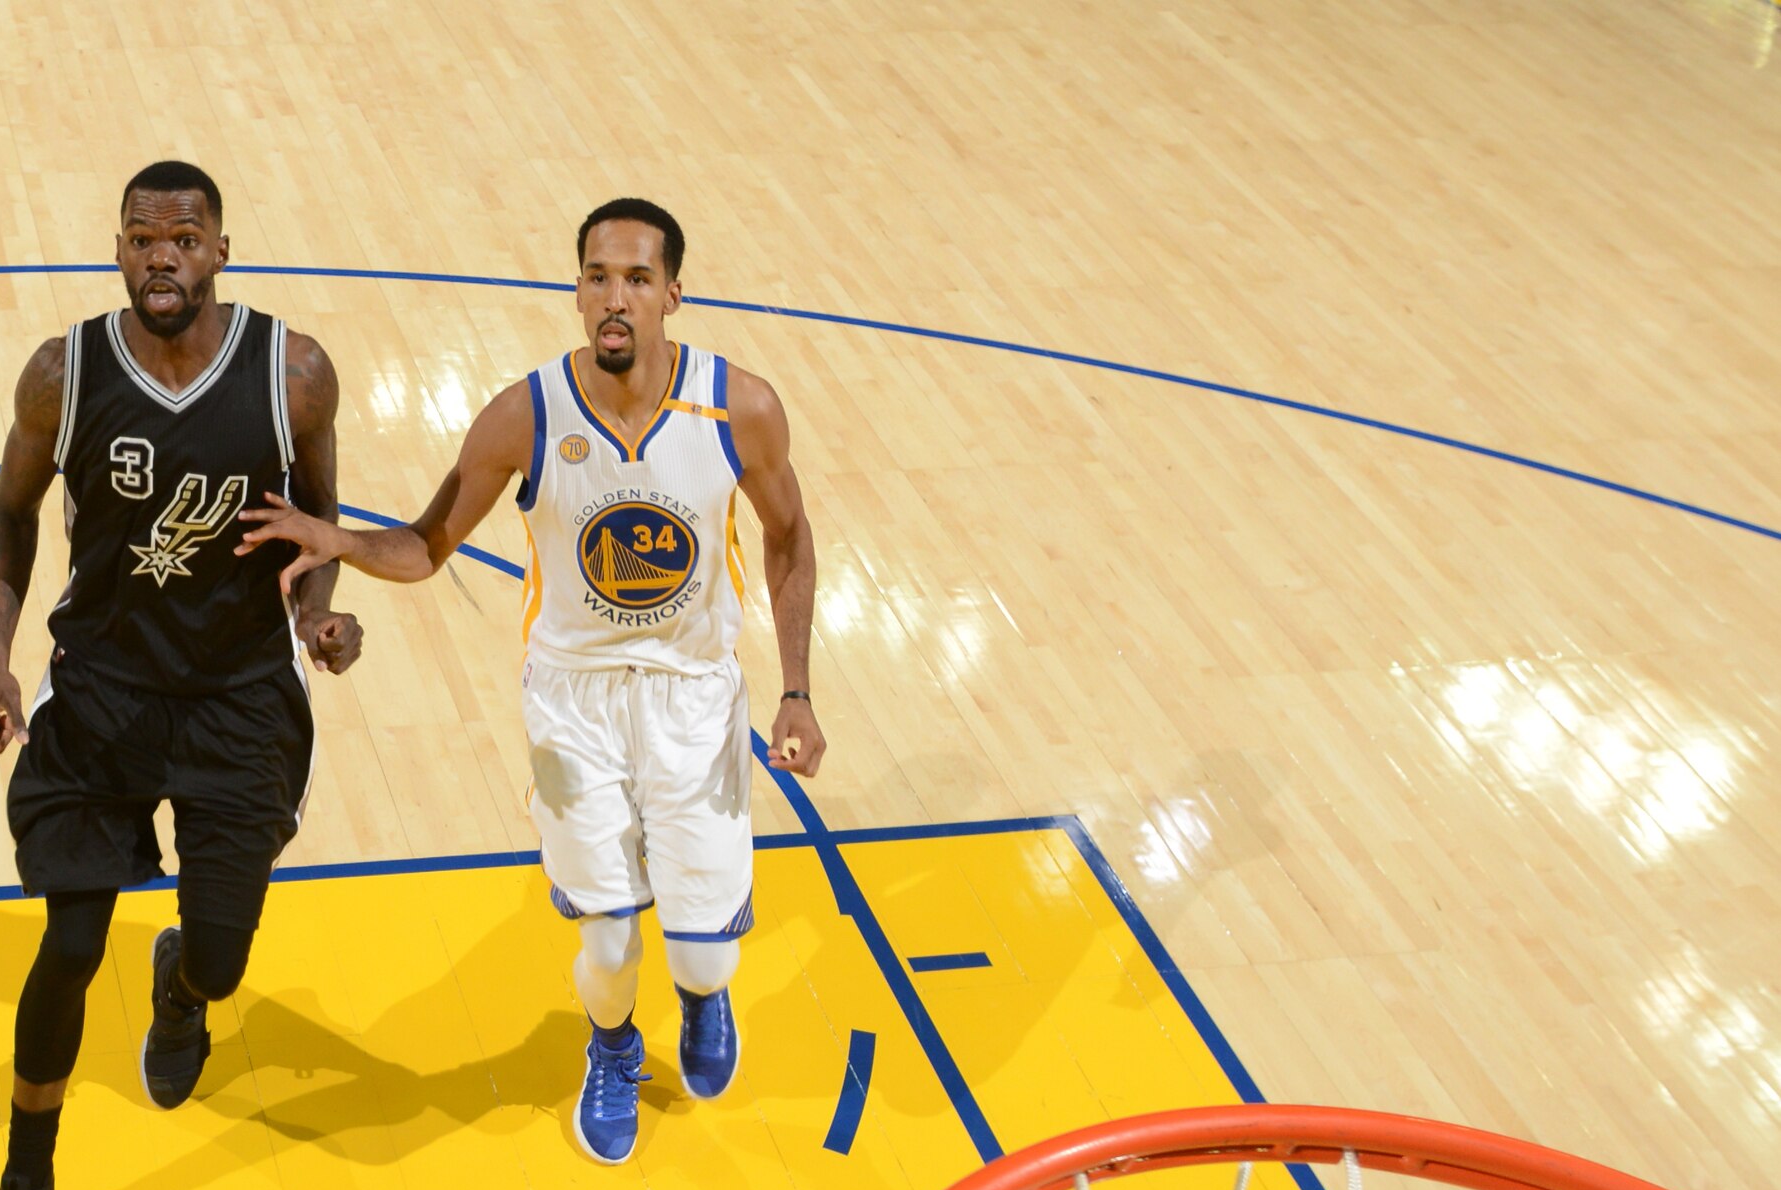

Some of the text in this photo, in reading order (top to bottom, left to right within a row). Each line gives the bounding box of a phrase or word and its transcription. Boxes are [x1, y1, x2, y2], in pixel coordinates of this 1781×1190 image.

[110, 436, 154, 499] 3
[566, 441, 582, 457] 70
[573, 488, 700, 526] GOLDEN STATE
[632, 524, 678, 553] 34
[583, 579, 703, 627] WARRIORS
